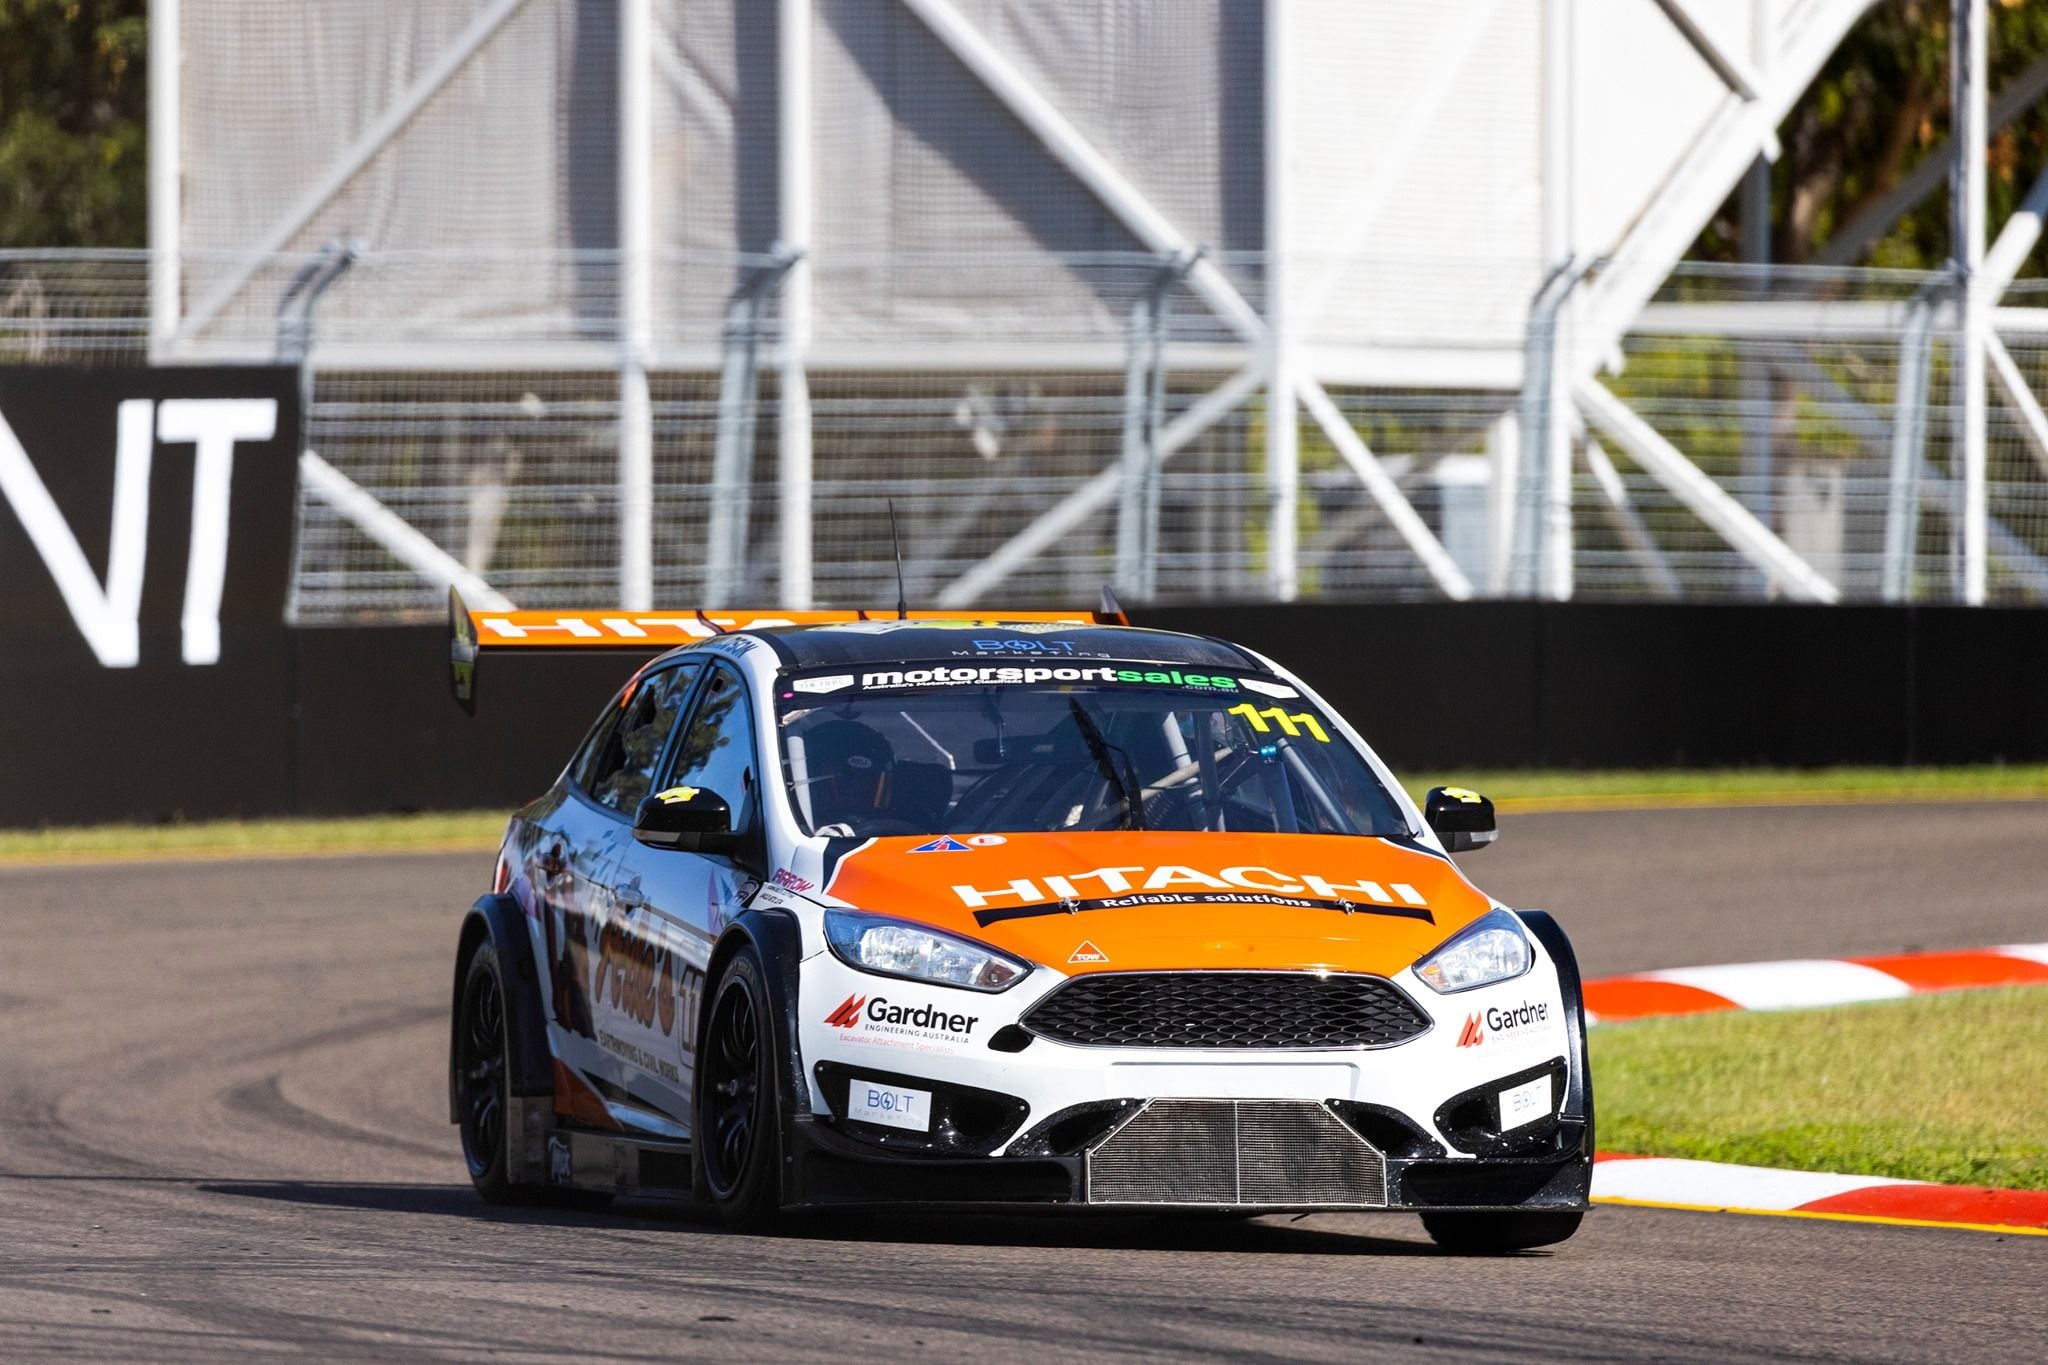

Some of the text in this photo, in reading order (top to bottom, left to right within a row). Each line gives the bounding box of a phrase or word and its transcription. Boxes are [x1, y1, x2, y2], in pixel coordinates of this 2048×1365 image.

[972, 639, 1076, 651] BOLT
[1227, 703, 1331, 743] 111
[951, 865, 1428, 907] HITACHI
[1100, 893, 1312, 908] Reliable solutions
[1076, 953, 1100, 961] TOW
[867, 997, 979, 1034] Gardner
[1486, 1000, 1549, 1032] Gardner
[864, 1024, 970, 1044] ENGINEERING AUSTRALIA
[867, 1089, 914, 1113] BOLT
